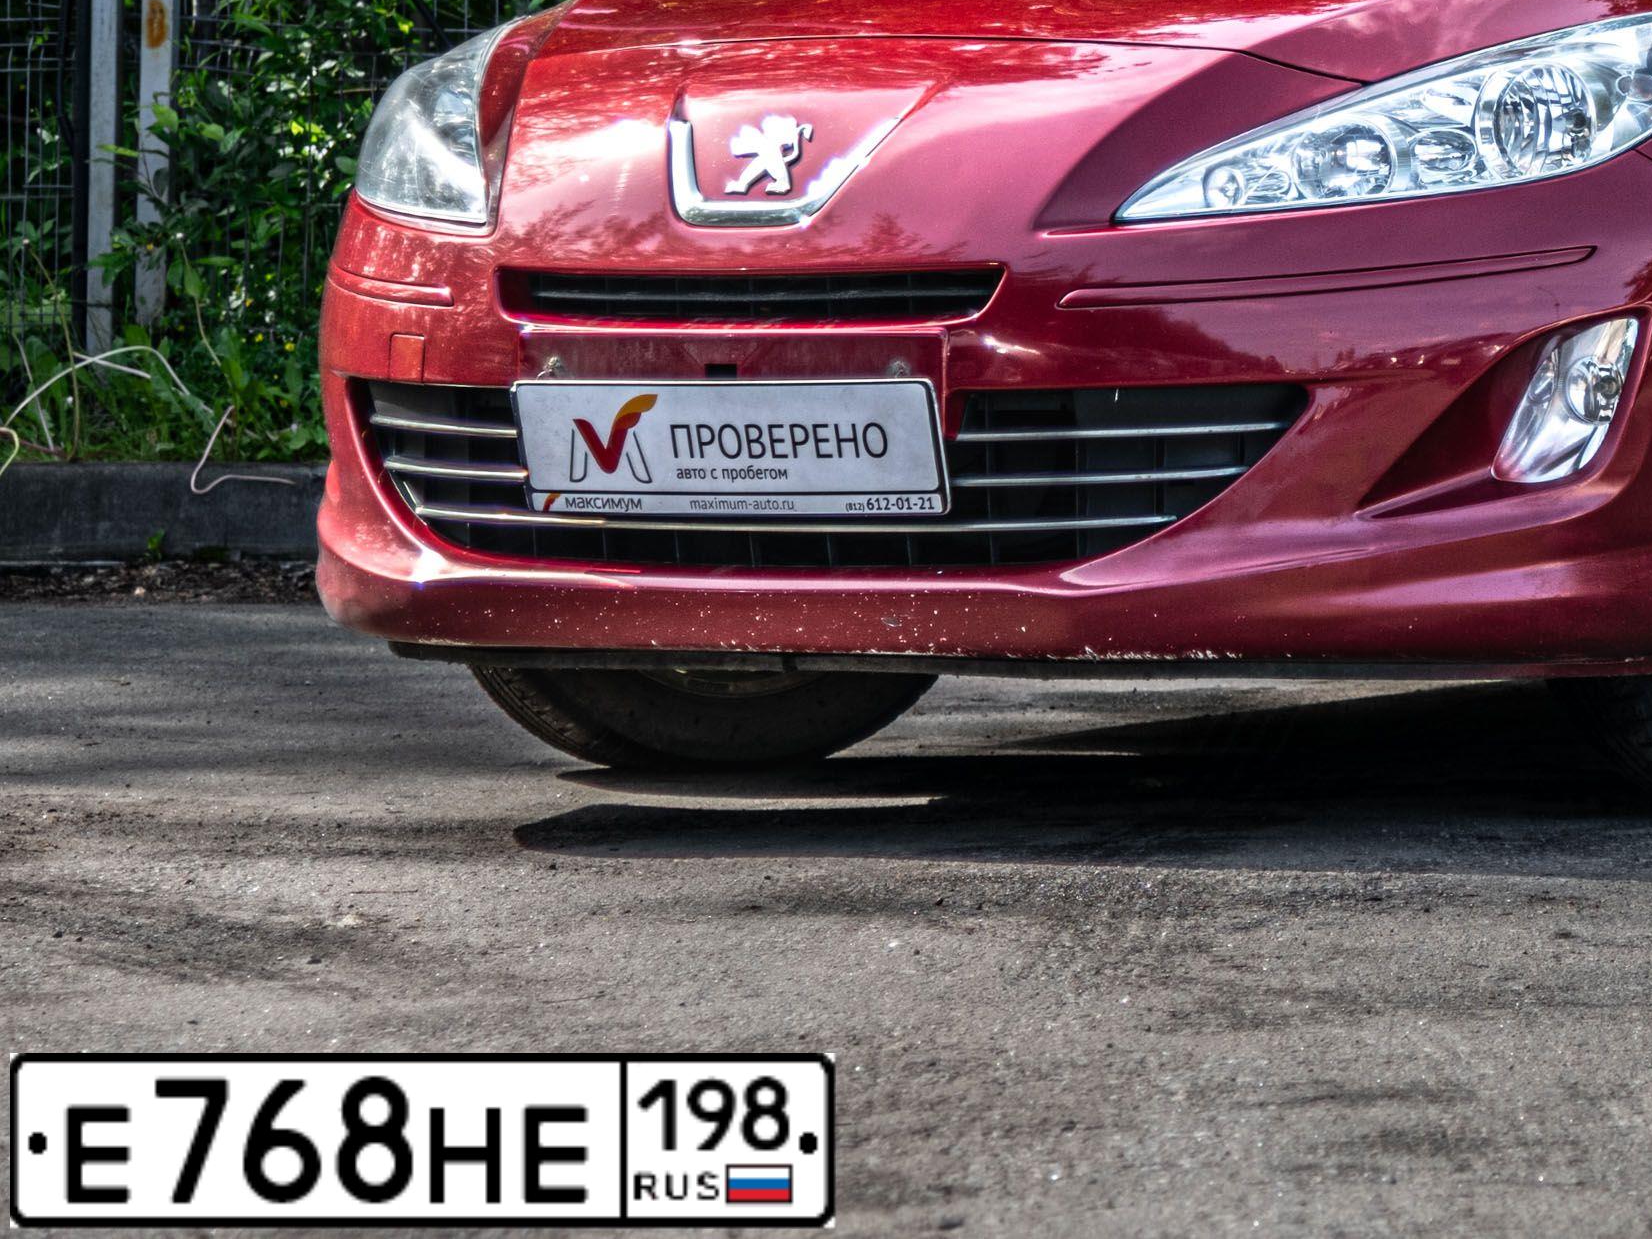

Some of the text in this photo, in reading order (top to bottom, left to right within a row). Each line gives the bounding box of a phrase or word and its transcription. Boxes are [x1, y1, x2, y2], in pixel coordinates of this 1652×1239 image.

[669, 422, 888, 460] ПРОВЕРЕНО
[676, 464, 788, 483] авто с пробегом
[689, 497, 795, 511] maximum-auto.ru
[845, 496, 935, 512] (812) 612-01-21
